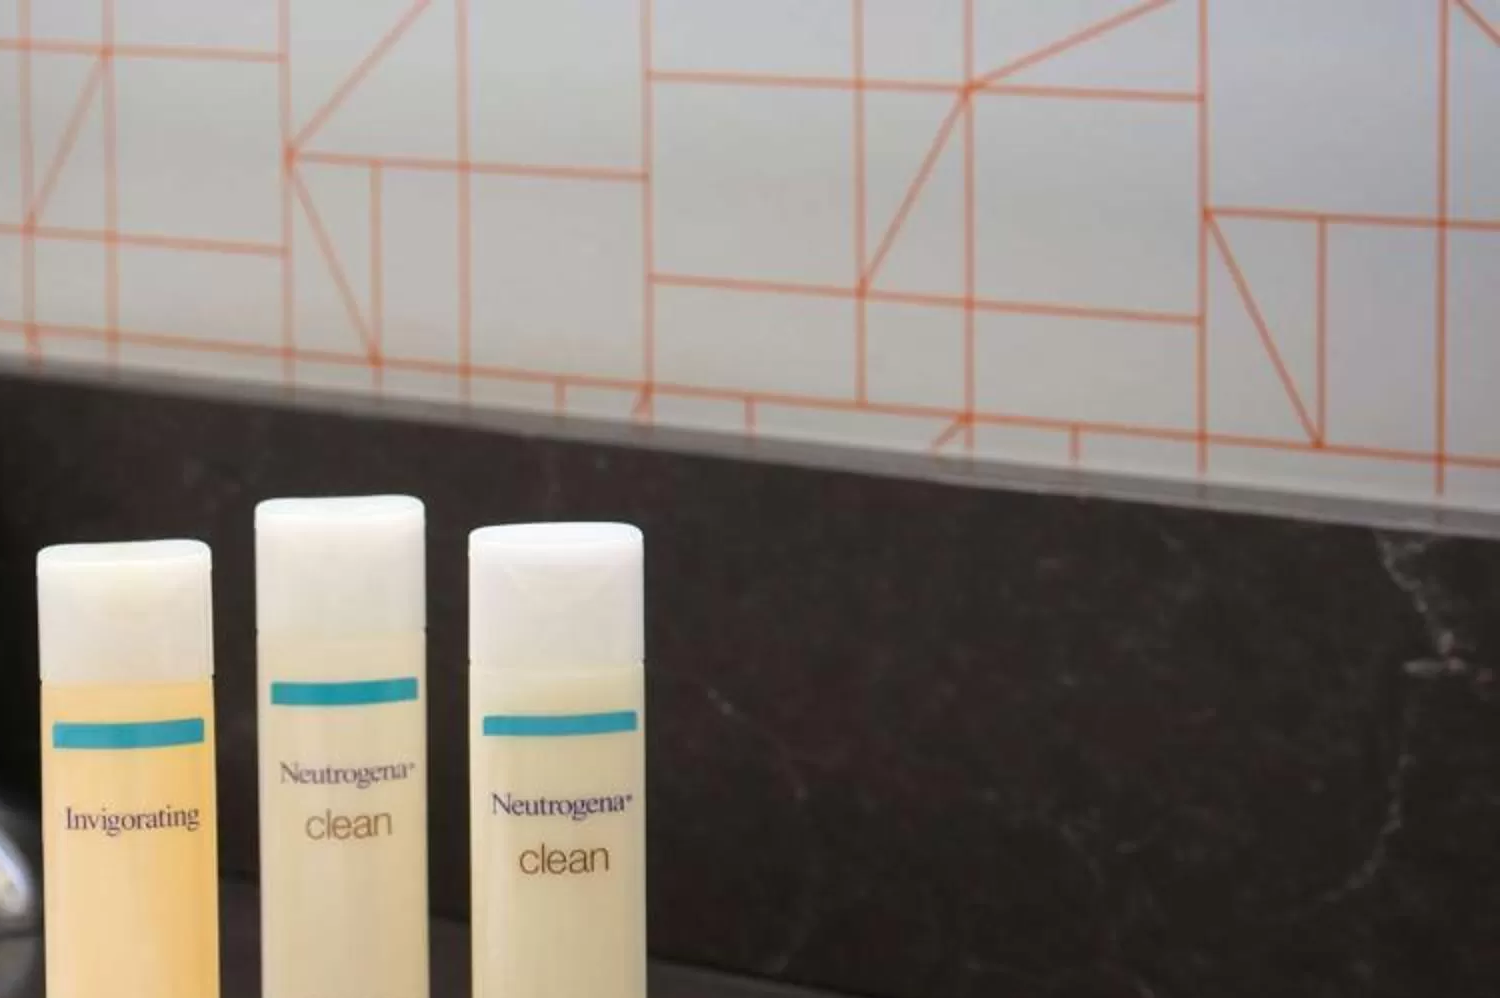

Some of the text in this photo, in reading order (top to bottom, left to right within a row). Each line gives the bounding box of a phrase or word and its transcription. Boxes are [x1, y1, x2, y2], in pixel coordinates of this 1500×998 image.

[65, 804, 200, 837] Invigorating
[305, 807, 393, 841] clean
[519, 842, 610, 875] clean
